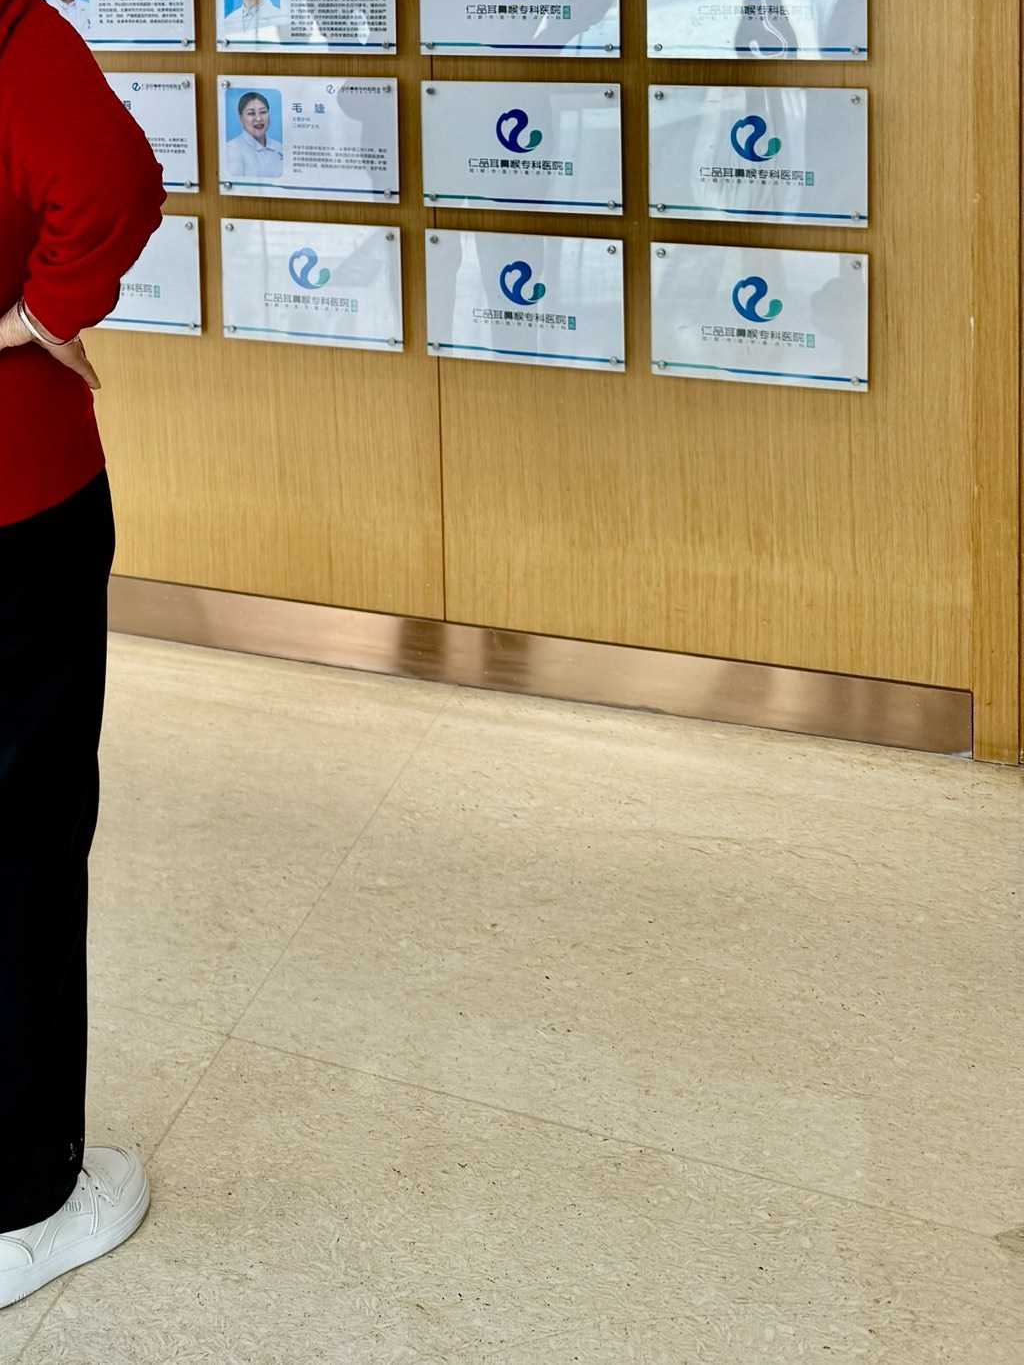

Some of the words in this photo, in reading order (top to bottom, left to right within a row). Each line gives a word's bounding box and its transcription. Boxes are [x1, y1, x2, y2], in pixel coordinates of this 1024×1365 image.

[466, 4, 561, 15] 仁品耳鼻喉专科医院
[468, 157, 563, 171] 仁品耳鼻喉专科医院
[699, 166, 804, 181] 仁品耳鼻喉专科医院
[263, 292, 350, 308] 仁品耳鼻喉专科医院
[472, 308, 567, 325] 仁品耳鼻喉专科医院
[701, 325, 805, 343] 仁品耳鼻喉专科医院
